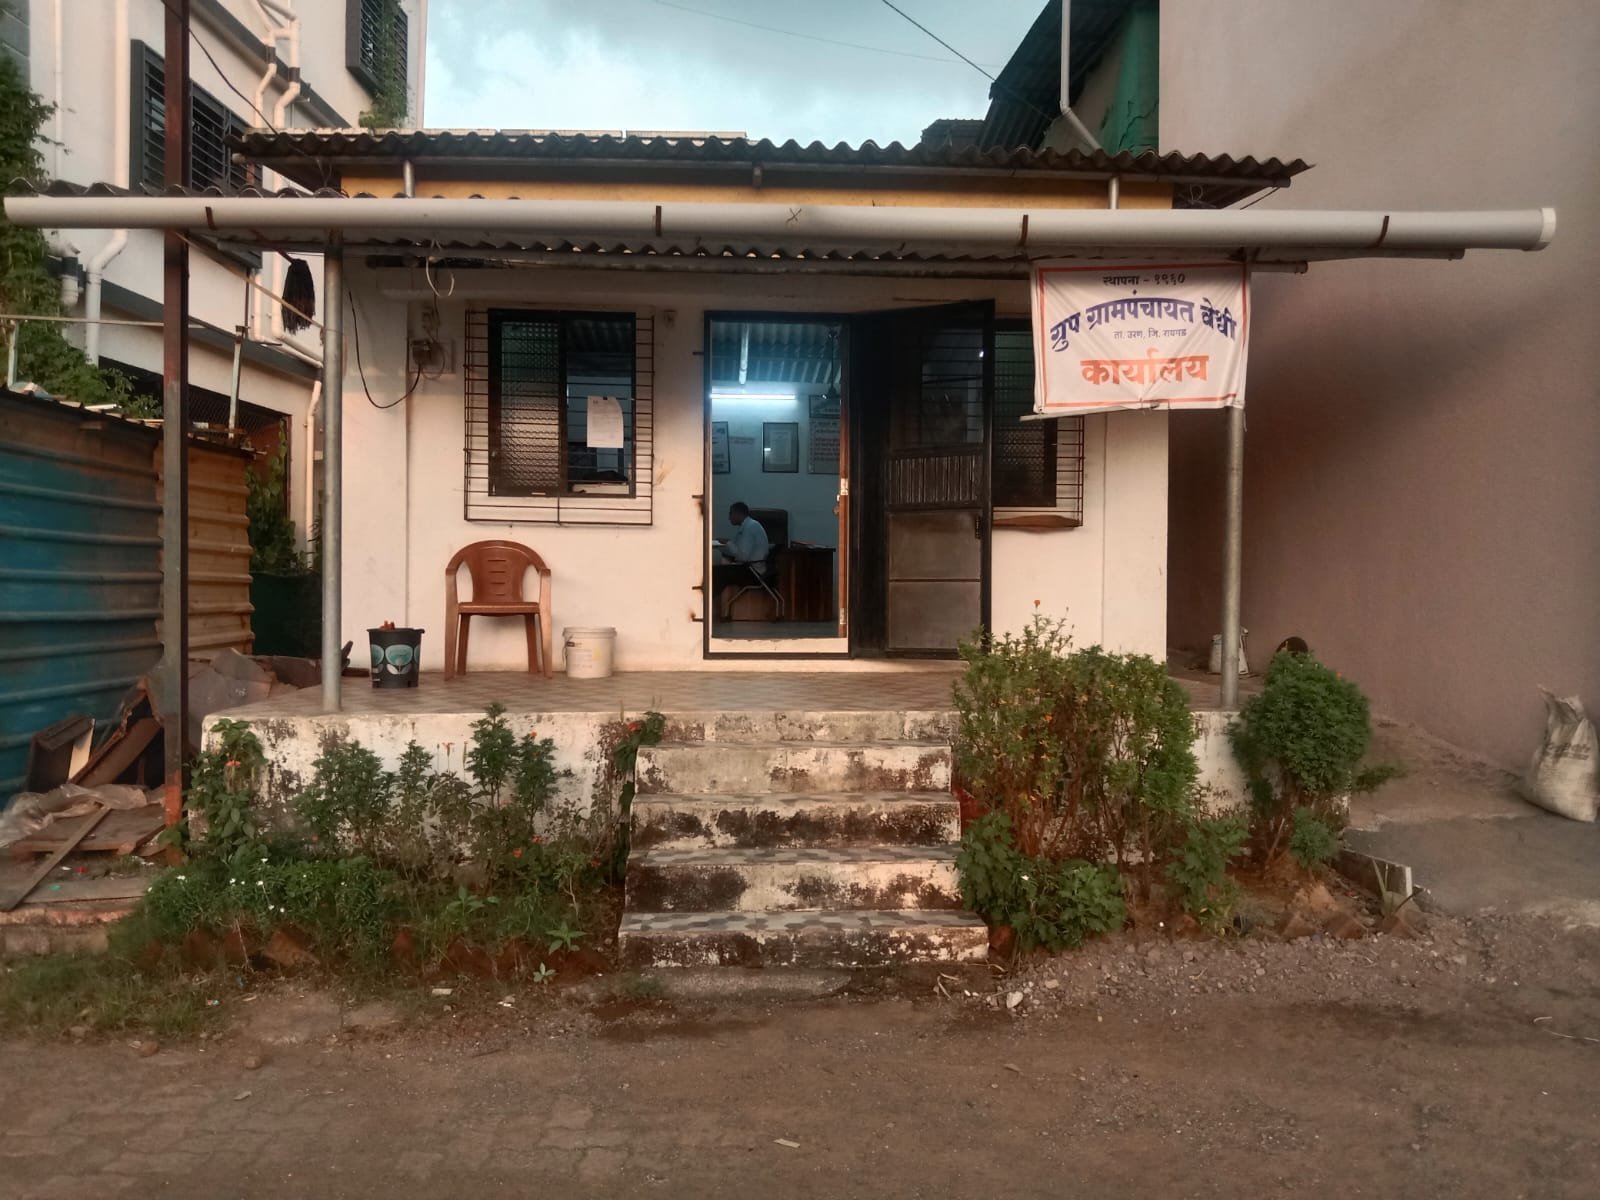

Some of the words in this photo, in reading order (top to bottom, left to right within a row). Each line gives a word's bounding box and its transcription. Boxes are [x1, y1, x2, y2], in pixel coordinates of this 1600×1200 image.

[1103, 275, 1140, 286] स्थापना
[1050, 311, 1081, 353] ग्रुप
[1086, 289, 1195, 331] ग्रामपंचायत
[1080, 346, 1210, 386] कार्यालय
